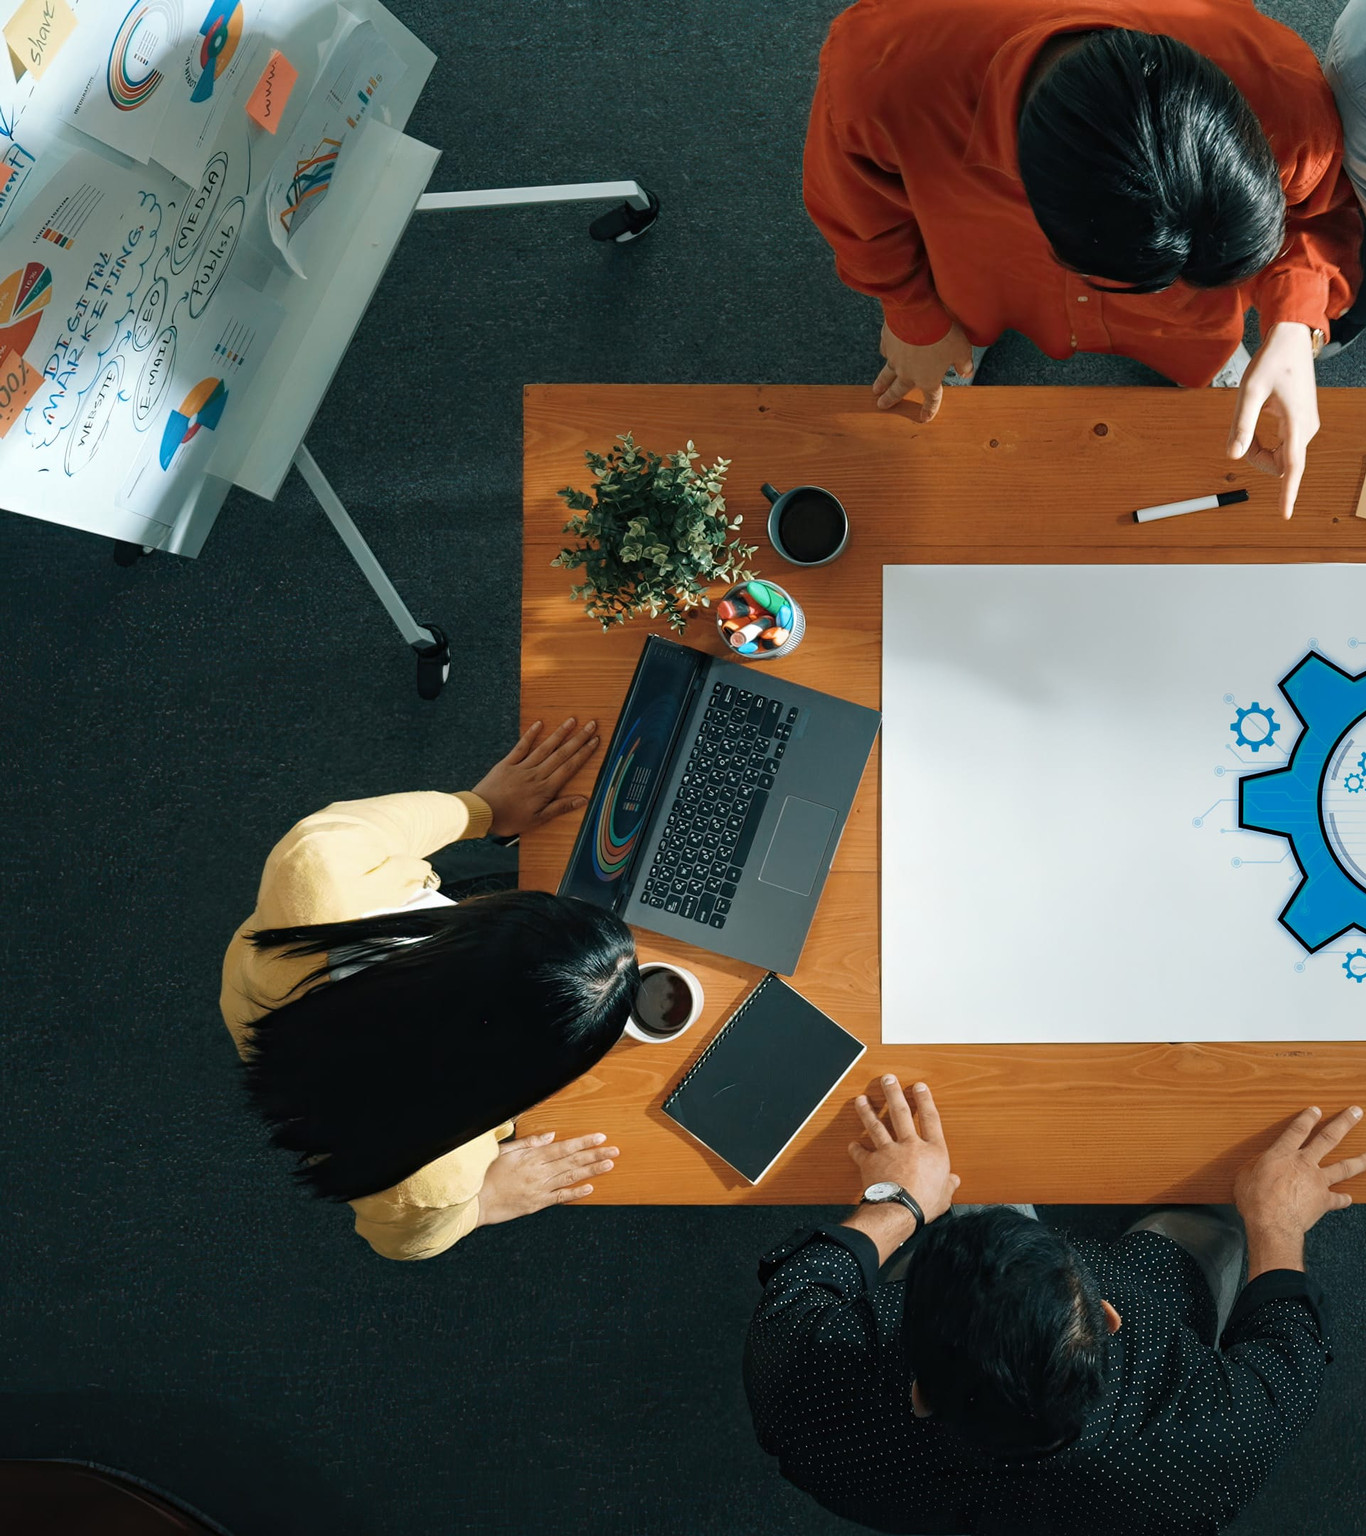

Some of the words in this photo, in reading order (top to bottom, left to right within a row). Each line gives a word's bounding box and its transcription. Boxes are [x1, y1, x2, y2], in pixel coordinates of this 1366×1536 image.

[178, 171, 219, 249] MEDIA
[43, 252, 113, 380] DIGITAL
[43, 226, 145, 424] MARKETING
[0, 359, 29, 418] 00%
[78, 370, 116, 447] WEBSITE
[140, 333, 173, 410] E-MAIL
